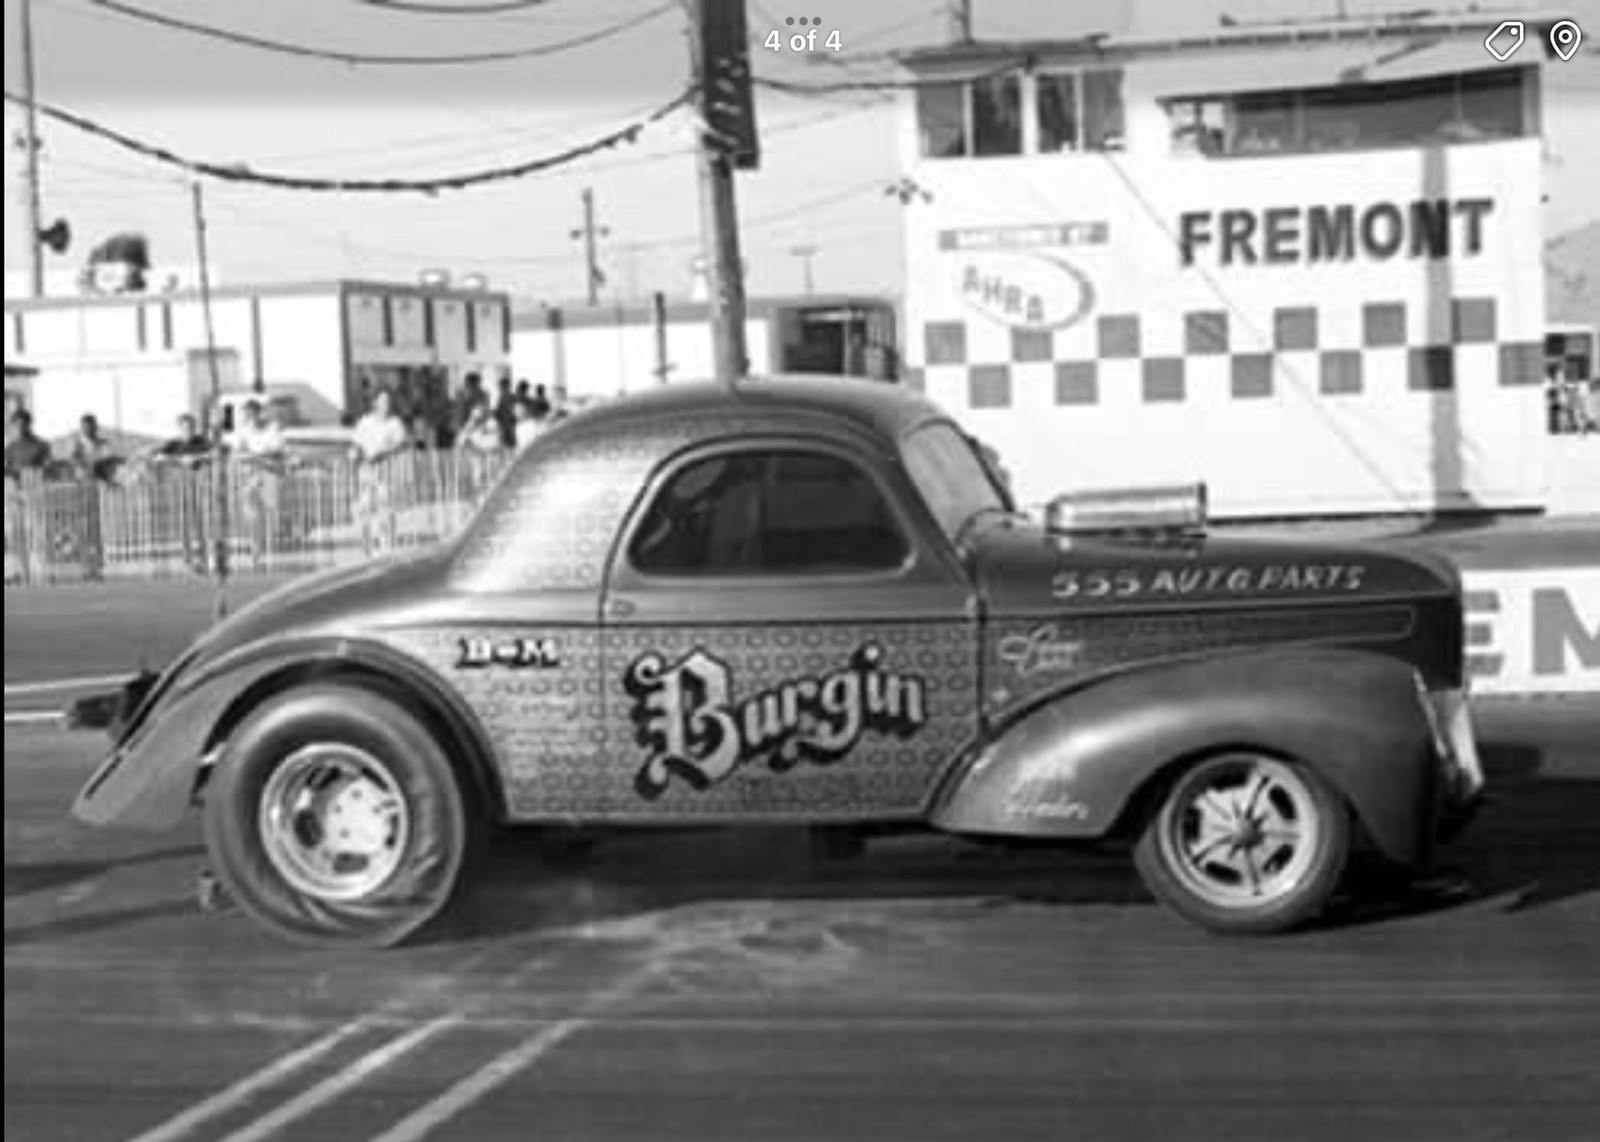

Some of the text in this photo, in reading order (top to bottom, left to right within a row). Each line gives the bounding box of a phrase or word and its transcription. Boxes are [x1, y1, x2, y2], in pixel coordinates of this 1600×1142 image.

[1180, 198, 1494, 266] FREMONT
[963, 265, 1044, 321] AHRA
[1258, 565, 1365, 590] PARTS
[624, 641, 926, 798] Burgin
